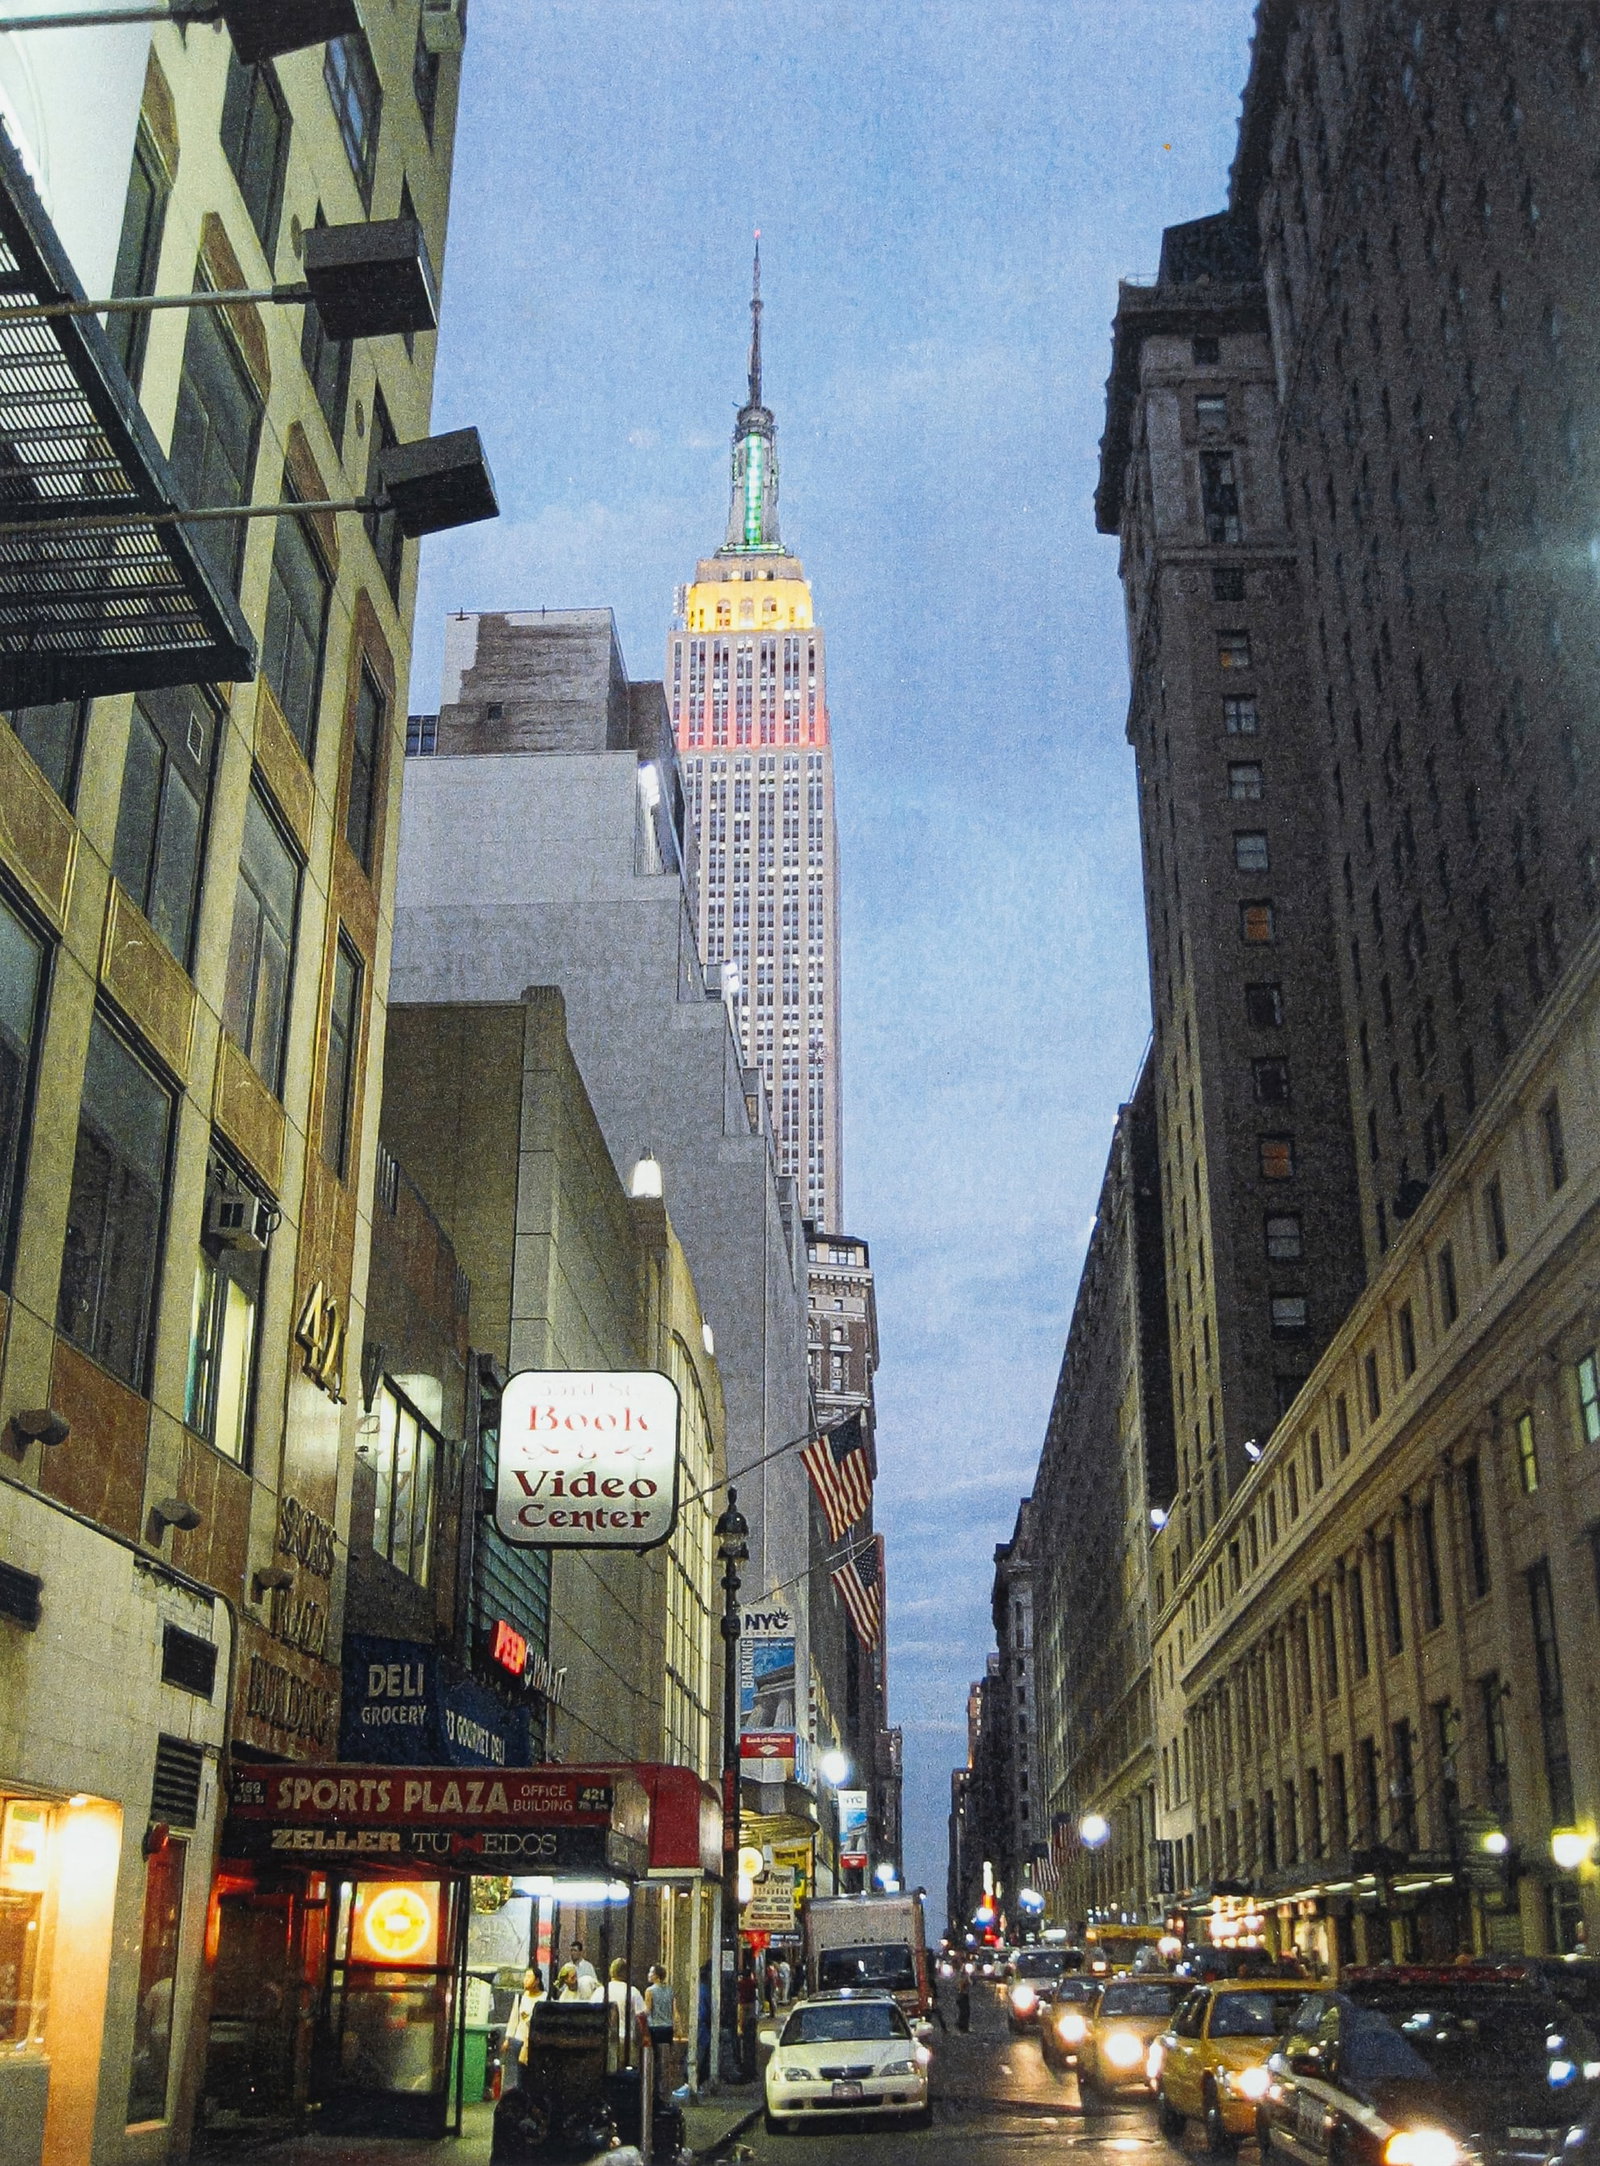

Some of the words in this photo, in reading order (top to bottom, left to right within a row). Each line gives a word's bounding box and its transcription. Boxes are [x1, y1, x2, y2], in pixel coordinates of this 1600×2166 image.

[527, 1405, 649, 1431] Book
[511, 1470, 658, 1498] Video
[518, 1503, 650, 1532] Center
[745, 1608, 791, 1630] NYC
[741, 1639, 755, 1689] BANKING
[368, 1663, 424, 1697] DELI
[361, 1705, 427, 1727] GROCERY
[277, 1777, 392, 1812] SPORTS
[403, 1780, 510, 1814] PLAZA
[521, 1784, 567, 1797] OFFICE
[582, 1788, 605, 1800] 421
[513, 1799, 573, 1812] BUILDING
[271, 1829, 401, 1851] ZELLER
